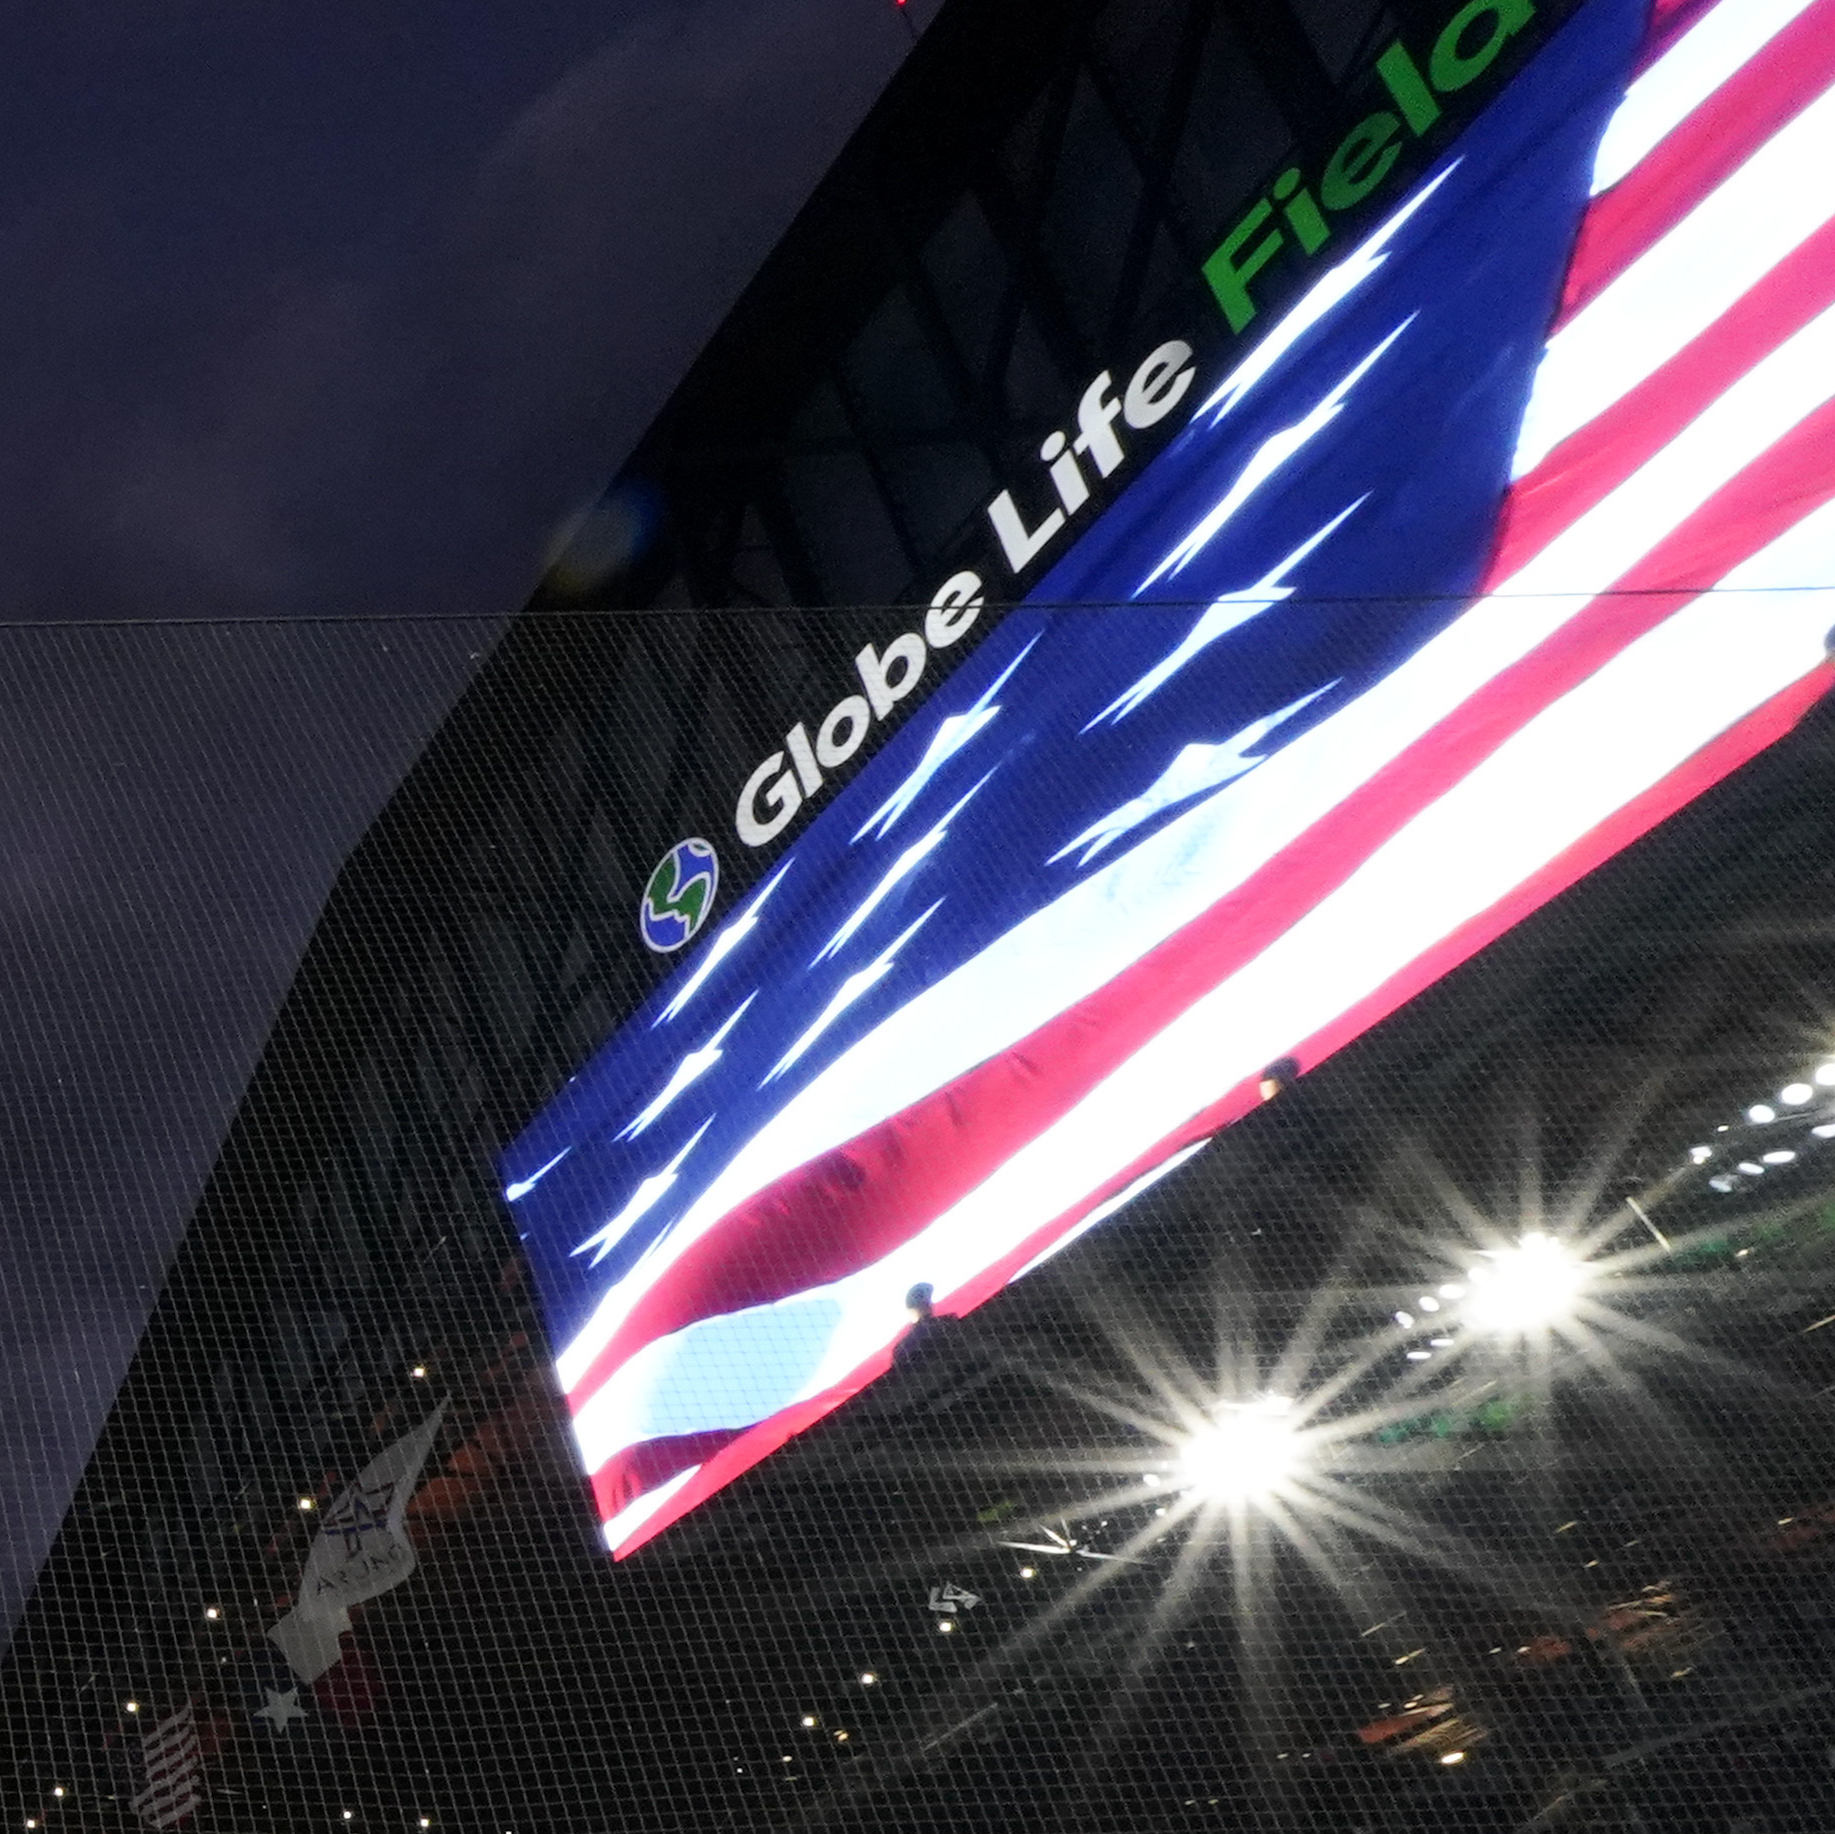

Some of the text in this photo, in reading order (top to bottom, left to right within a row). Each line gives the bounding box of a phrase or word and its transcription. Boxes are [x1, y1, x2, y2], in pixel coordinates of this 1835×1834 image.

[736, 0, 1537, 847] Globe Life Field
